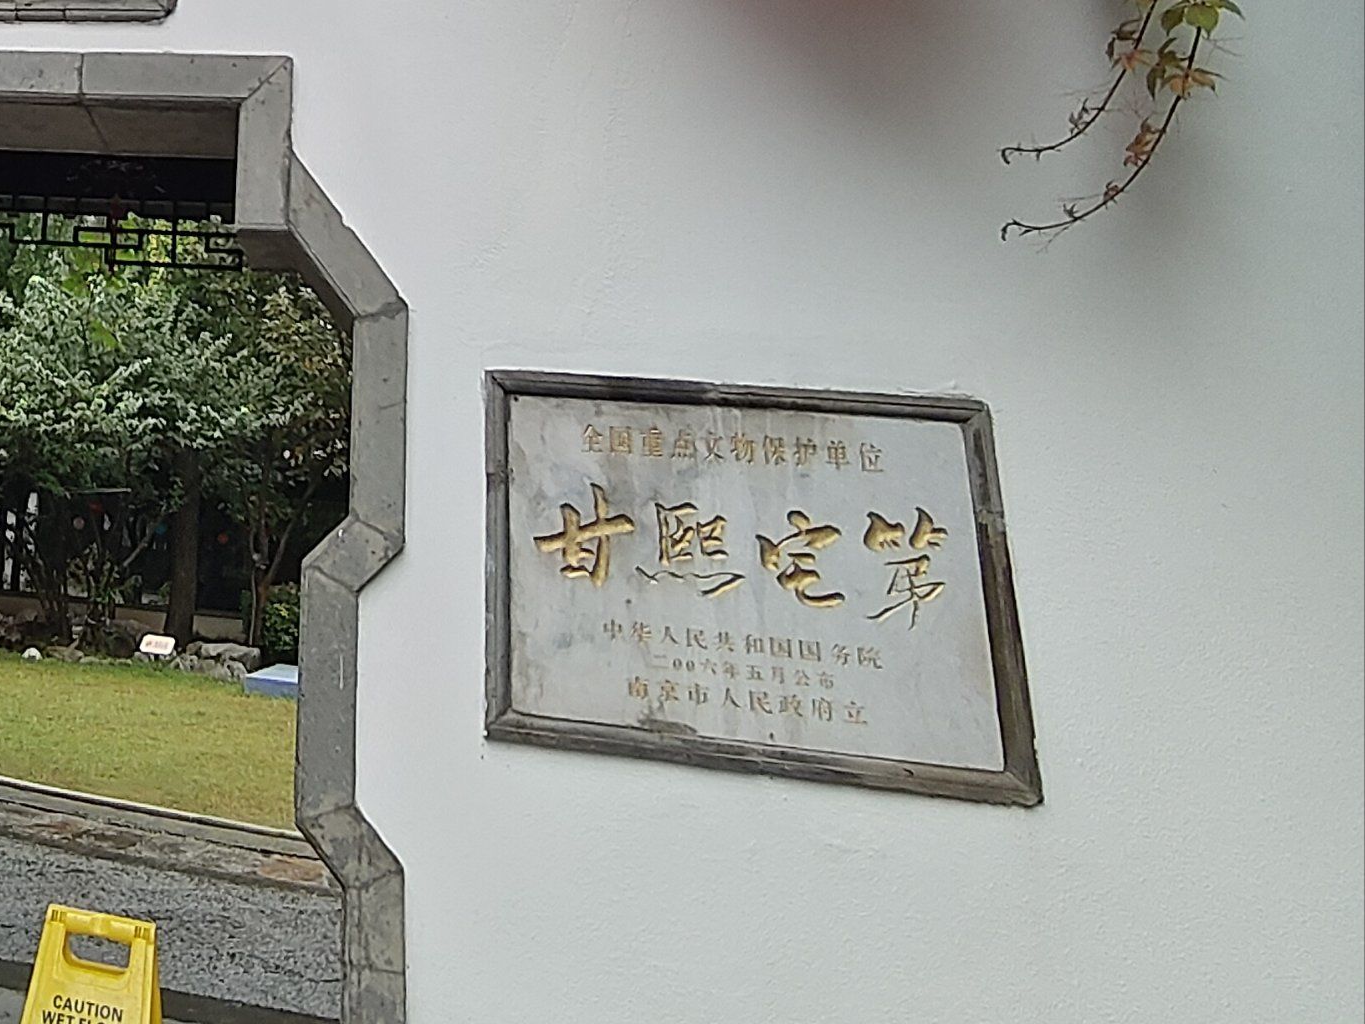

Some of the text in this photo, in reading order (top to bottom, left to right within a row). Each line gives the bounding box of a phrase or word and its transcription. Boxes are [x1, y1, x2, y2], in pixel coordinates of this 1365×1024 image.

[582, 424, 883, 472] 全国重点文物保护单位
[533, 481, 948, 630] 甘熙宅第
[603, 619, 883, 669] 中华人民共和国国务院
[627, 675, 868, 725] 南京市人民政府立
[42, 1009, 75, 1024] WET
[53, 994, 123, 1022] CAUTION
